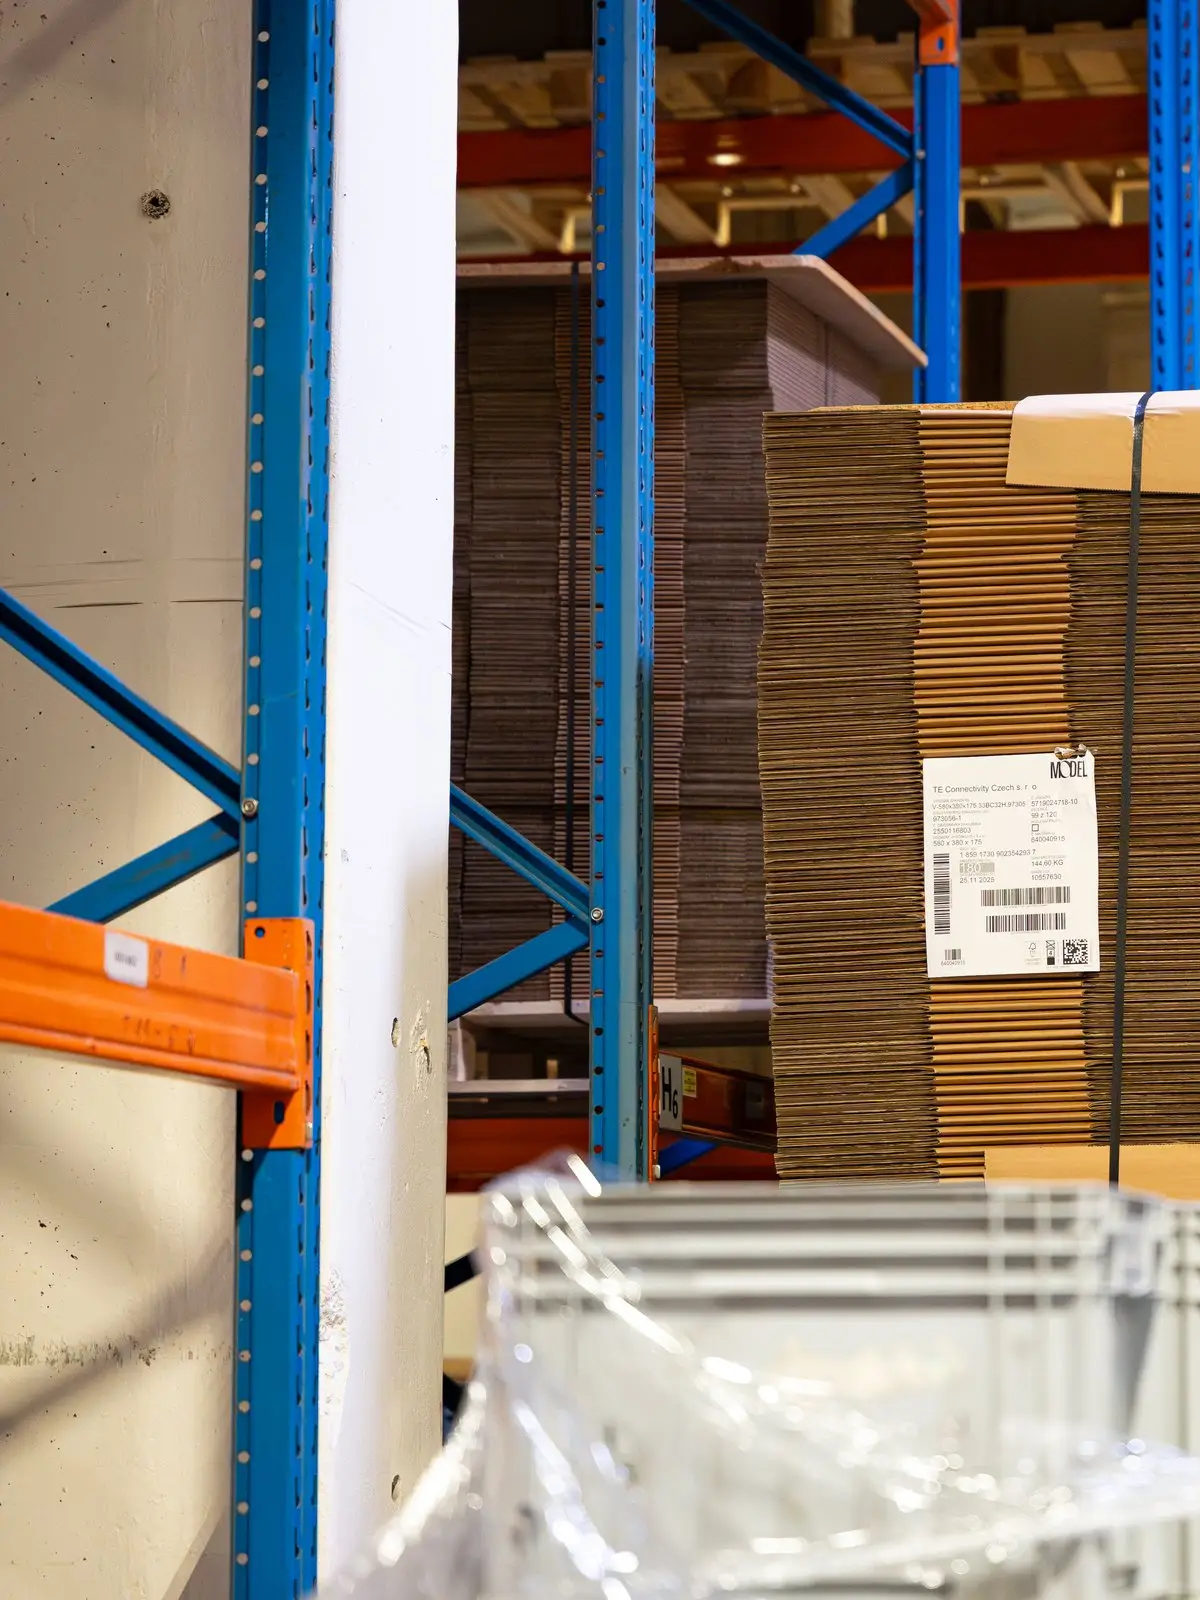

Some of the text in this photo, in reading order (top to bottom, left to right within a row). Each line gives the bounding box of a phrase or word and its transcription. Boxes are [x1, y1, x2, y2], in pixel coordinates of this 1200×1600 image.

[1050, 761, 1088, 779] MODEL
[932, 786, 944, 794] TE
[945, 784, 990, 794] Connectivity
[991, 783, 1015, 792] Czech
[1053, 858, 1064, 866] KG
